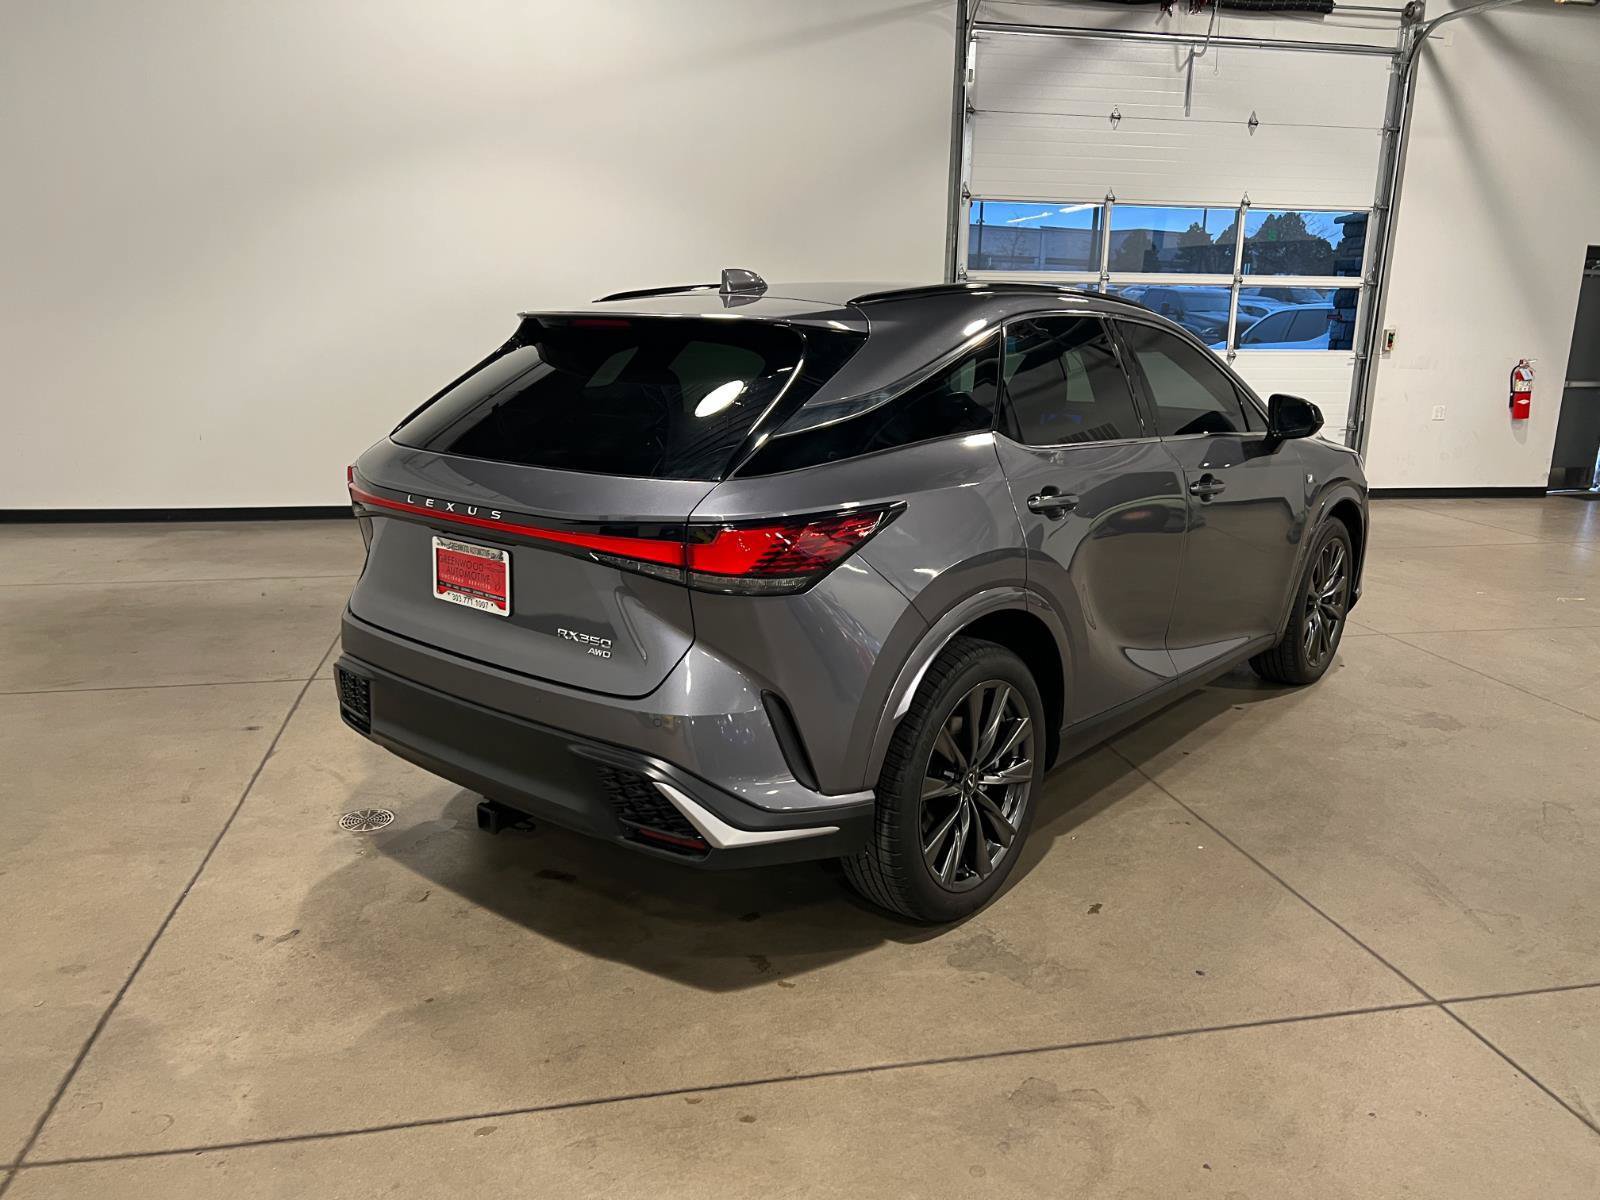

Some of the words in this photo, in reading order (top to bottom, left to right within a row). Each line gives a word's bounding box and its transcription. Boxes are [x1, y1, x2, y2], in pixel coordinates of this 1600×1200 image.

[407, 494, 502, 520] LEXUS
[557, 628, 612, 649] RX350
[587, 647, 611, 659] AWD
